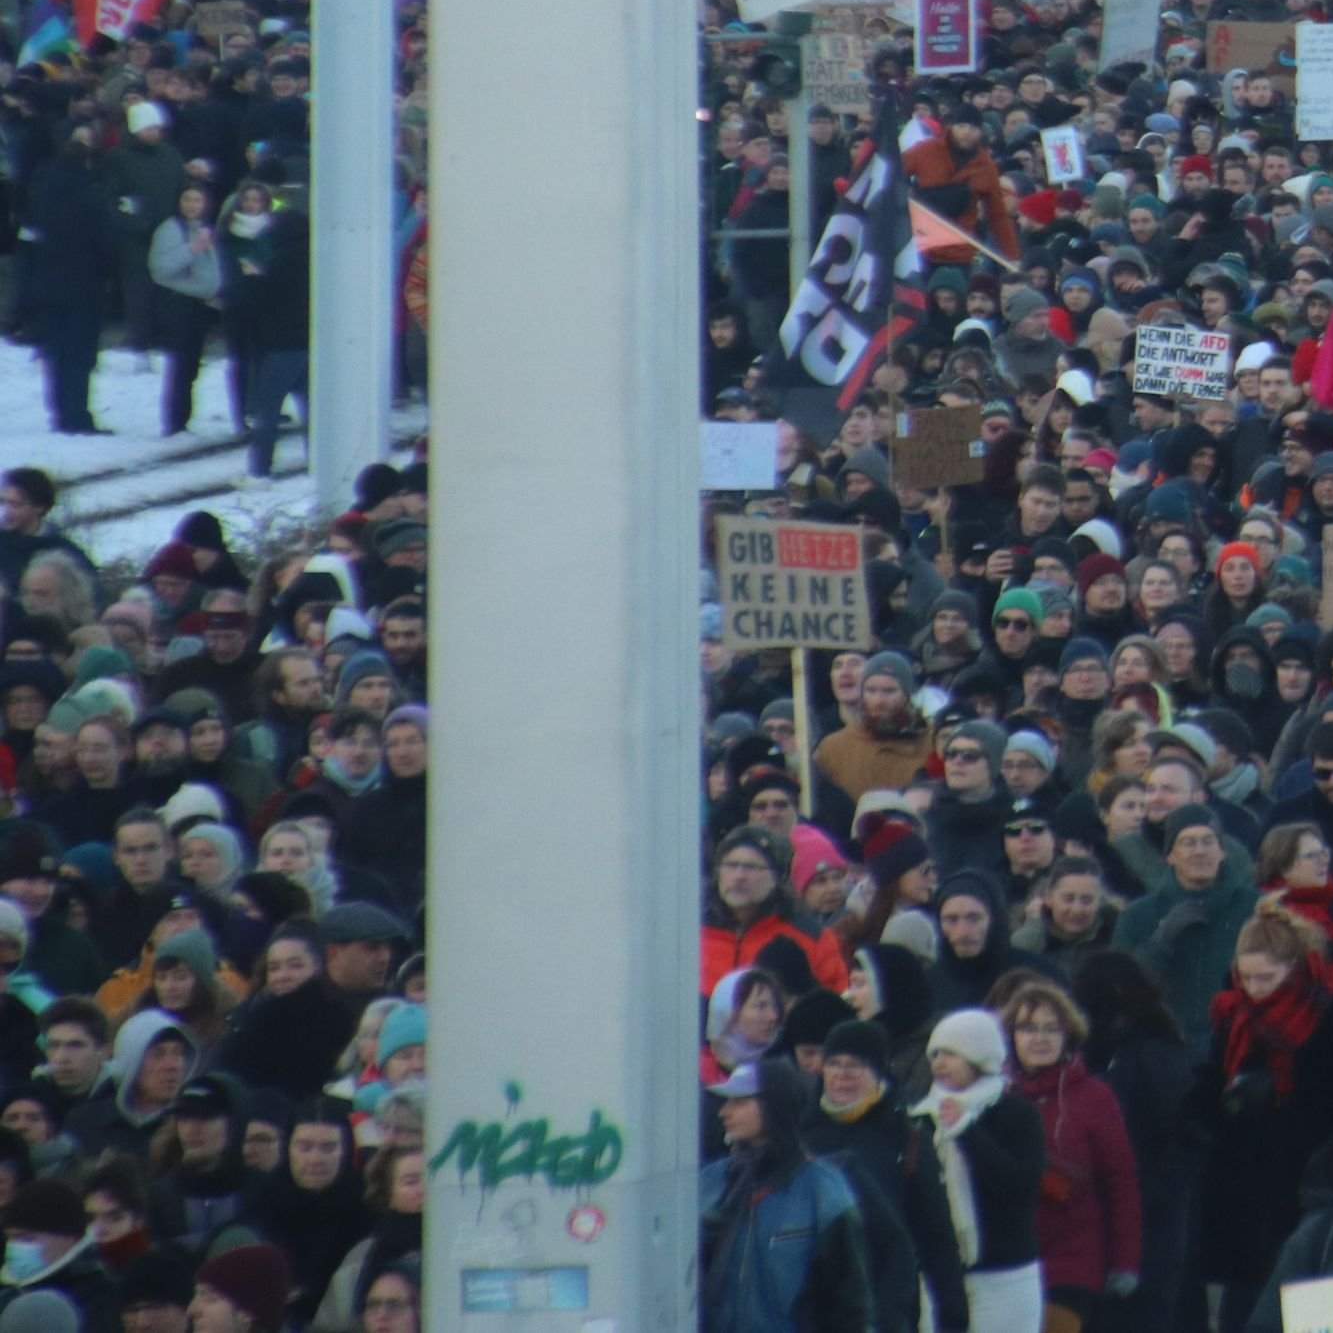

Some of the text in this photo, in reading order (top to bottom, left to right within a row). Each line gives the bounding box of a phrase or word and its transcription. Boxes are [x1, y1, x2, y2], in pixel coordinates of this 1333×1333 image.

[1138, 345, 1219, 366] DIE ANTWORT
[1174, 332, 1195, 347] DIE
[1200, 334, 1228, 351] AFD
[728, 531, 858, 568] GIB HETZE
[731, 573, 857, 606] KEINE
[732, 609, 858, 643] CHANCE
